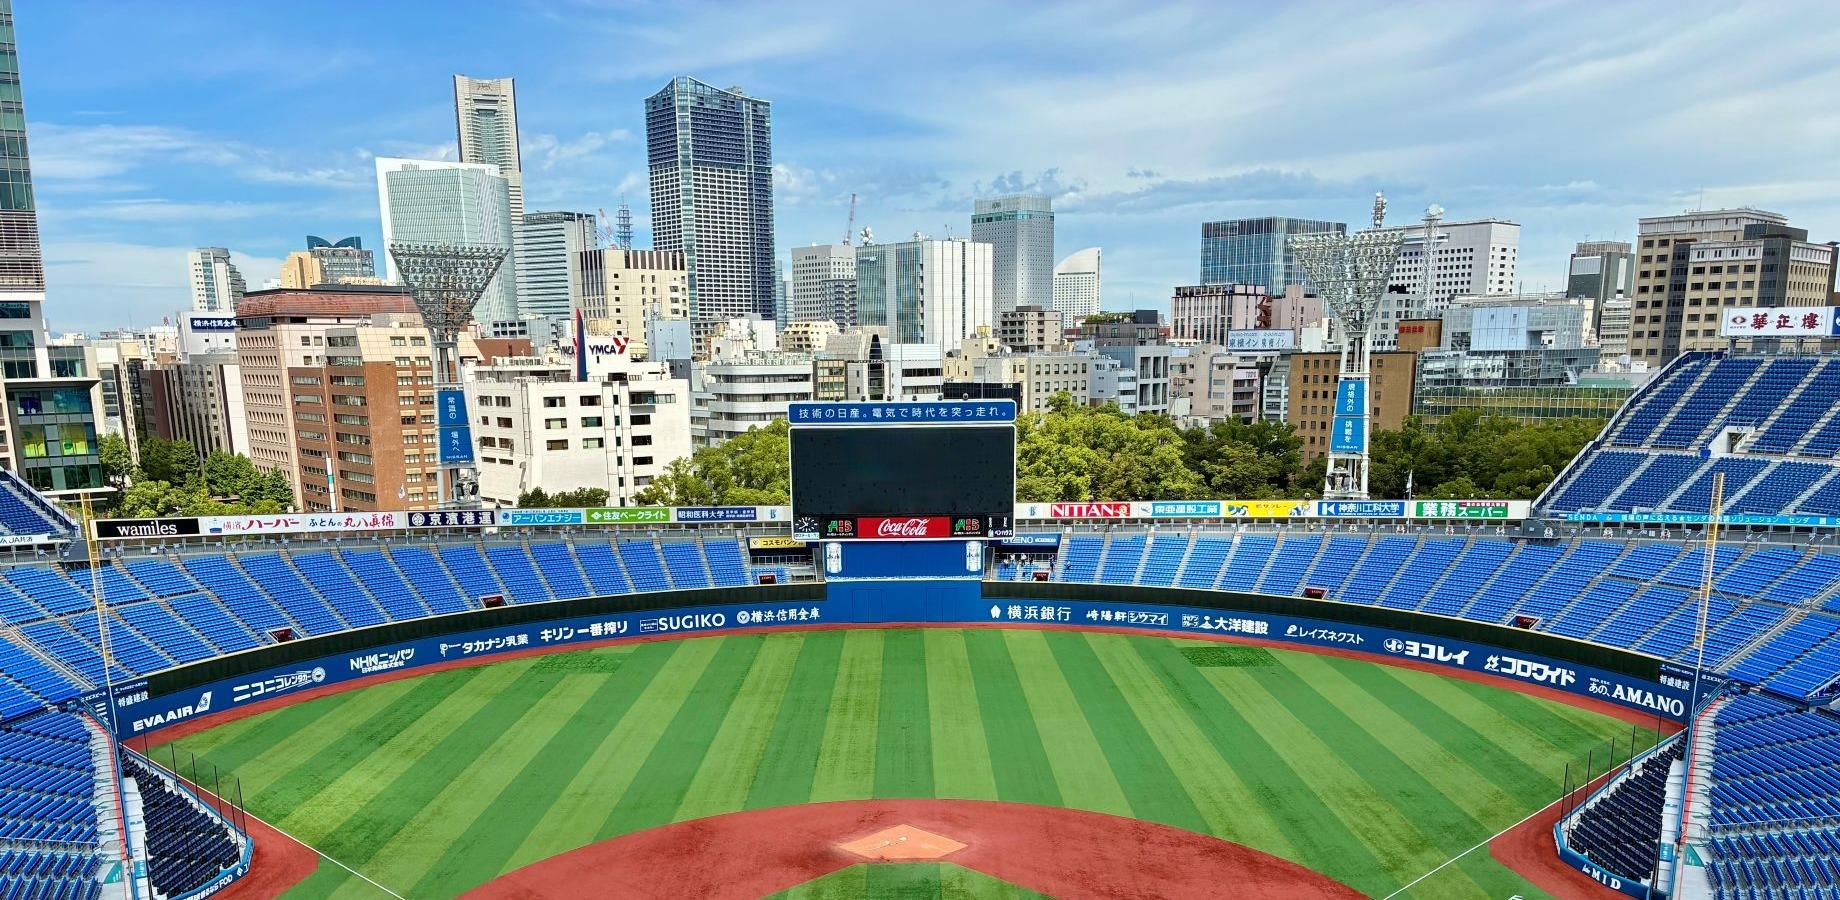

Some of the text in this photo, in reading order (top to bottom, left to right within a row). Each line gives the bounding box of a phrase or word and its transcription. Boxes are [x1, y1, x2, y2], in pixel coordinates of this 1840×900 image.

[588, 345, 616, 355] YMCA
[603, 511, 667, 520] 住友ベークライト
[678, 510, 725, 519] 昭和医科大学
[1051, 504, 1114, 517] NITTAN
[1338, 502, 1400, 513] 神奈川工科大学
[1422, 502, 1504, 517] 業務スーパー
[513, 513, 581, 523] アーバンエナジー
[116, 521, 178, 536] wamiles
[877, 518, 931, 536] Coca-Cola
[750, 607, 821, 623] 横浜信用金庫
[1007, 604, 1072, 621] 横浜銀行
[1086, 610, 1127, 621] 崎陽軒
[658, 613, 726, 631] SUGIKO
[1214, 617, 1269, 635] 大洋建設
[462, 633, 528, 654] タカナシ乳業
[1299, 627, 1364, 645] レイズネクスト
[1405, 640, 1470, 665] ヨコレイ
[1501, 656, 1576, 686] コロワイド
[1611, 684, 1685, 717] AMANO
[133, 705, 193, 732] EVA AIR
